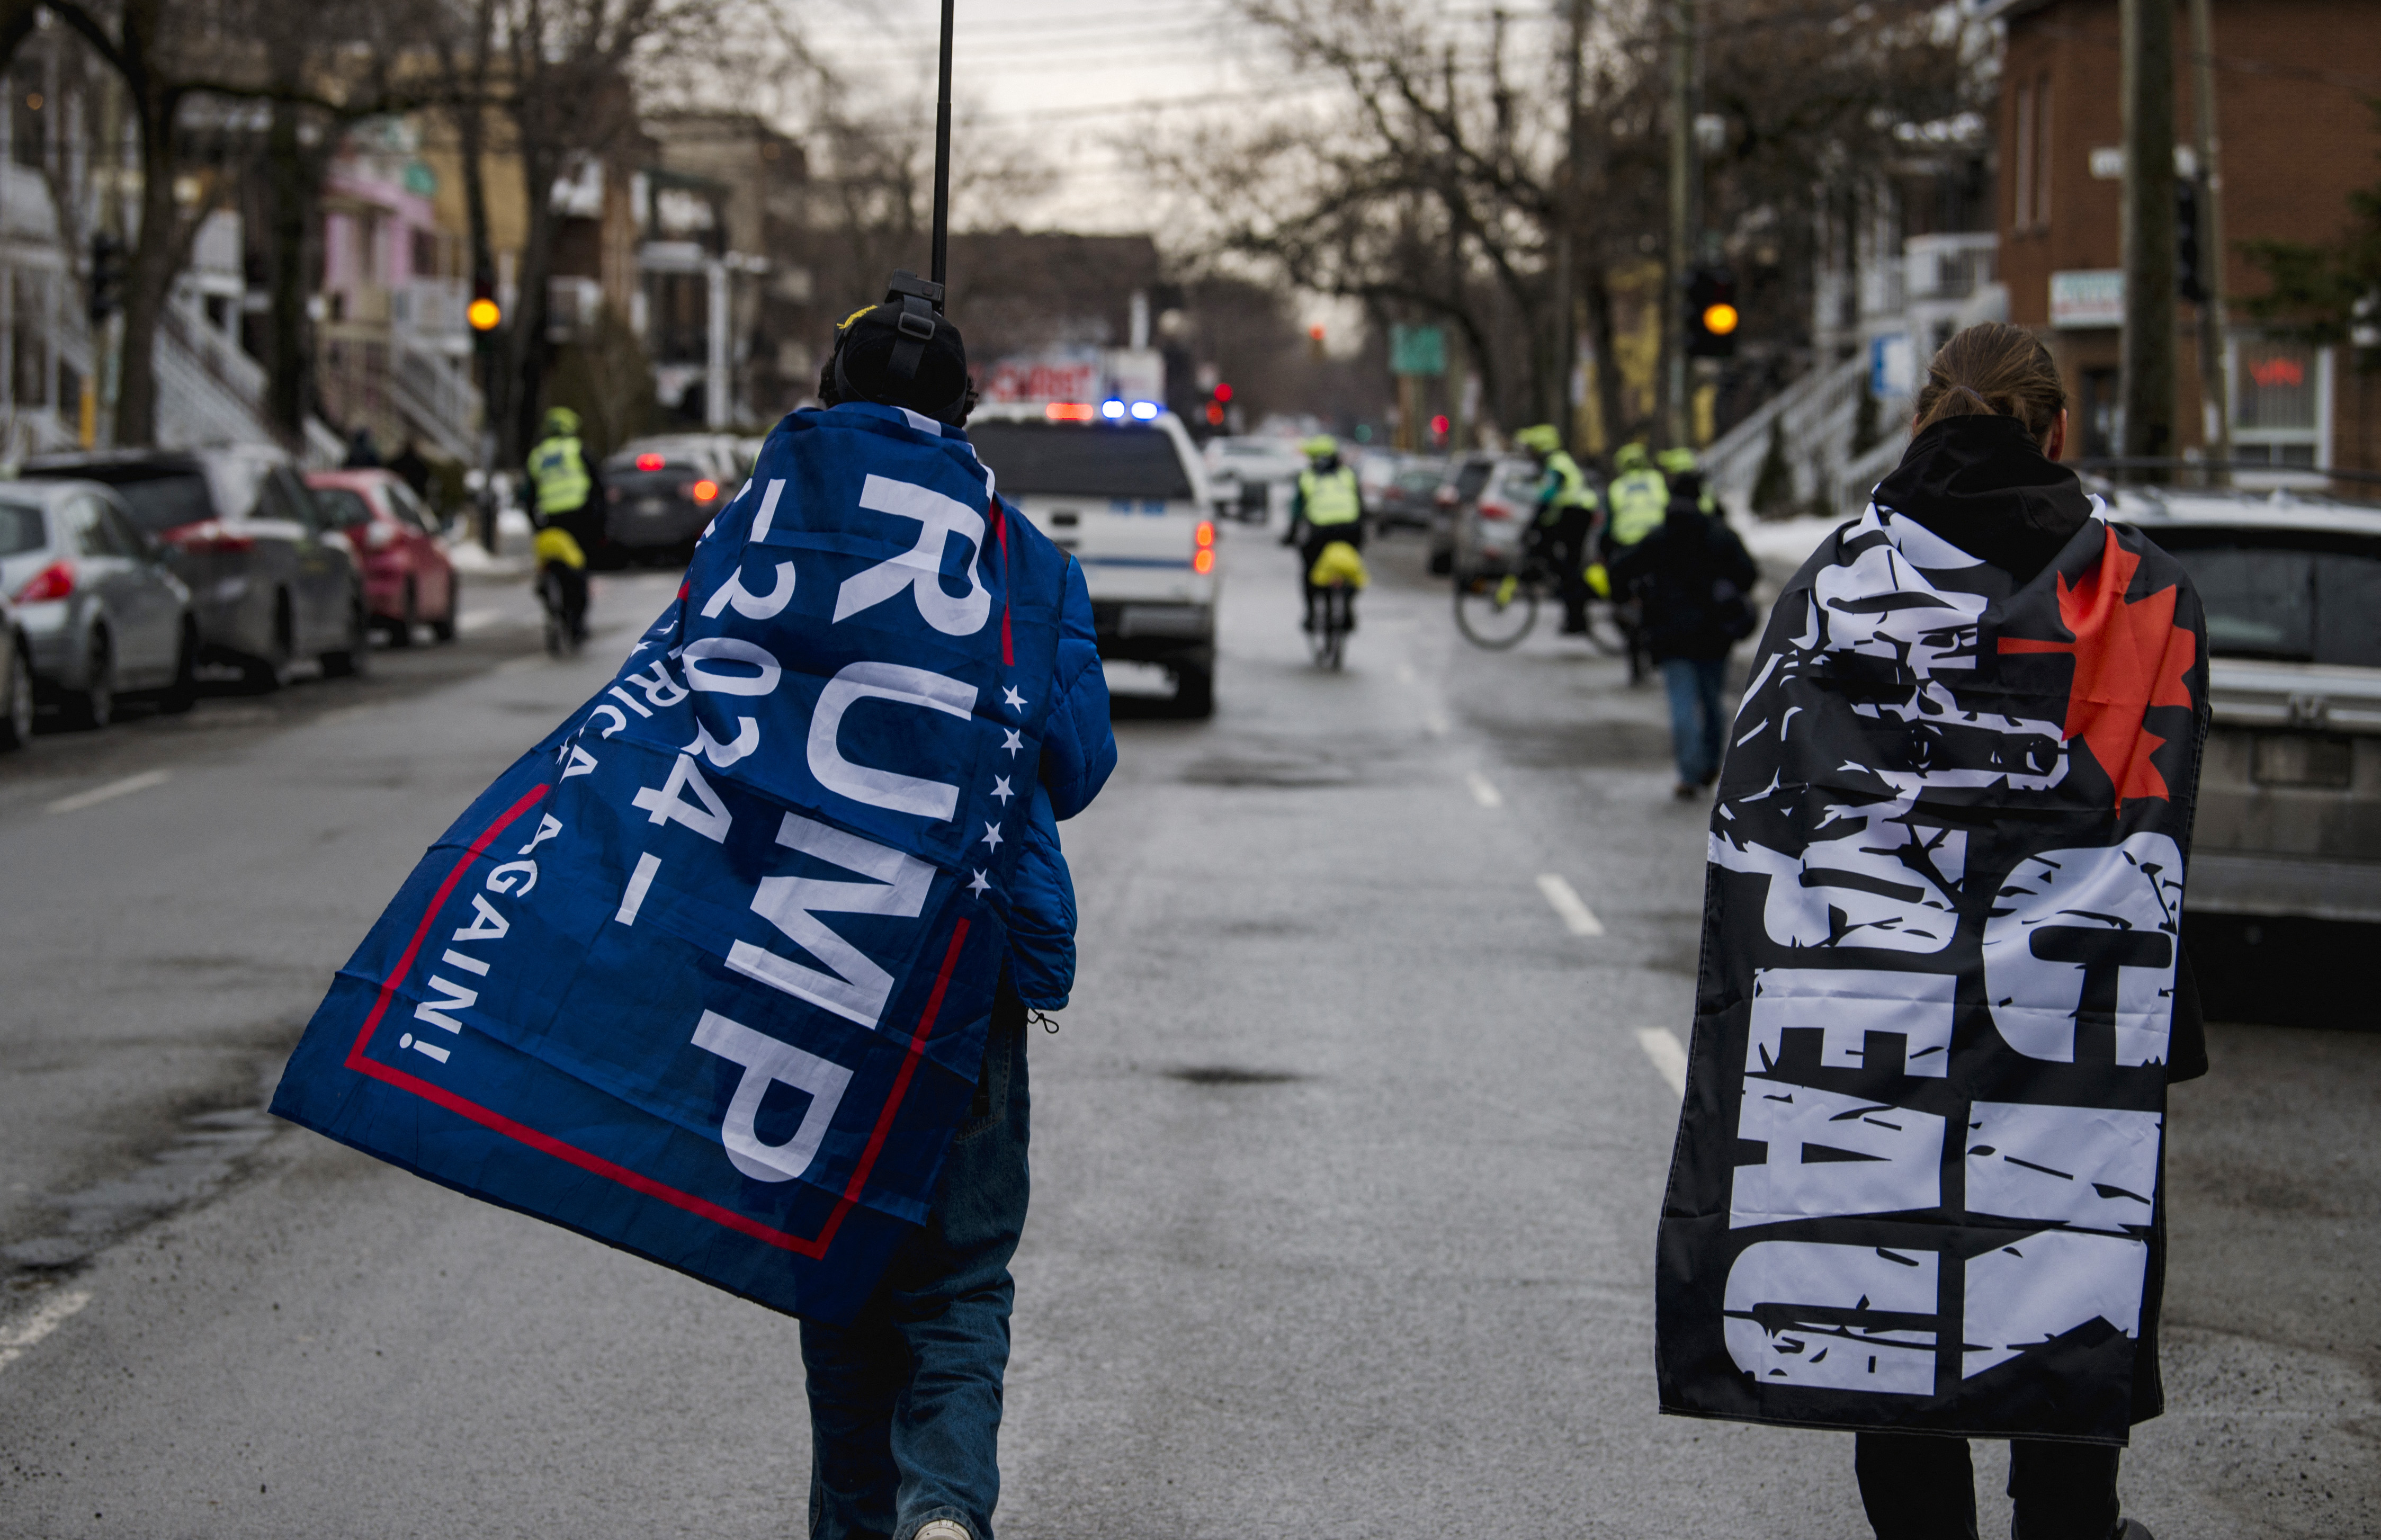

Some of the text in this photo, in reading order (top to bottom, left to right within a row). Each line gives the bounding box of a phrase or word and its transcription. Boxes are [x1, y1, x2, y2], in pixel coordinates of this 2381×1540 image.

[399, 644, 690, 1064] RICA AGAIN!
[690, 406, 996, 1183] RUMP
